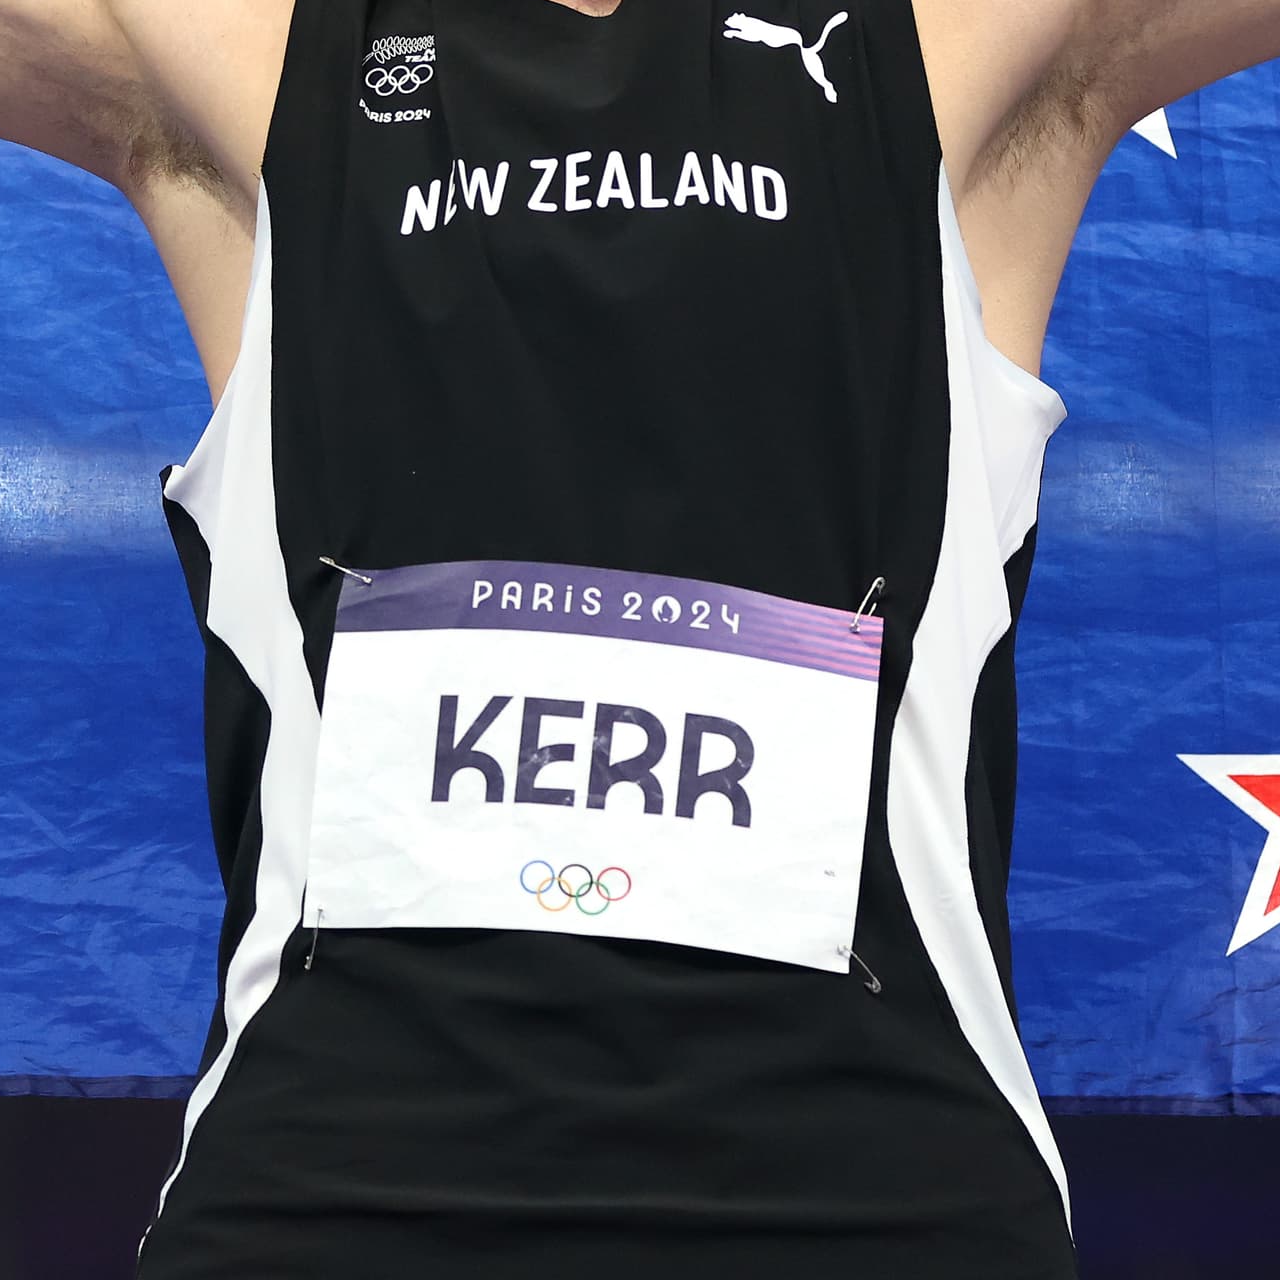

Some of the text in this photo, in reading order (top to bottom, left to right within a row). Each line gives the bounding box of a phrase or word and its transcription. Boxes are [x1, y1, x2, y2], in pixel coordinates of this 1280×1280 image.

[358, 98, 431, 123] PARIS 2024
[527, 150, 788, 221] ZEALAND
[621, 591, 741, 634] 2024
[430, 694, 755, 829] KERR
